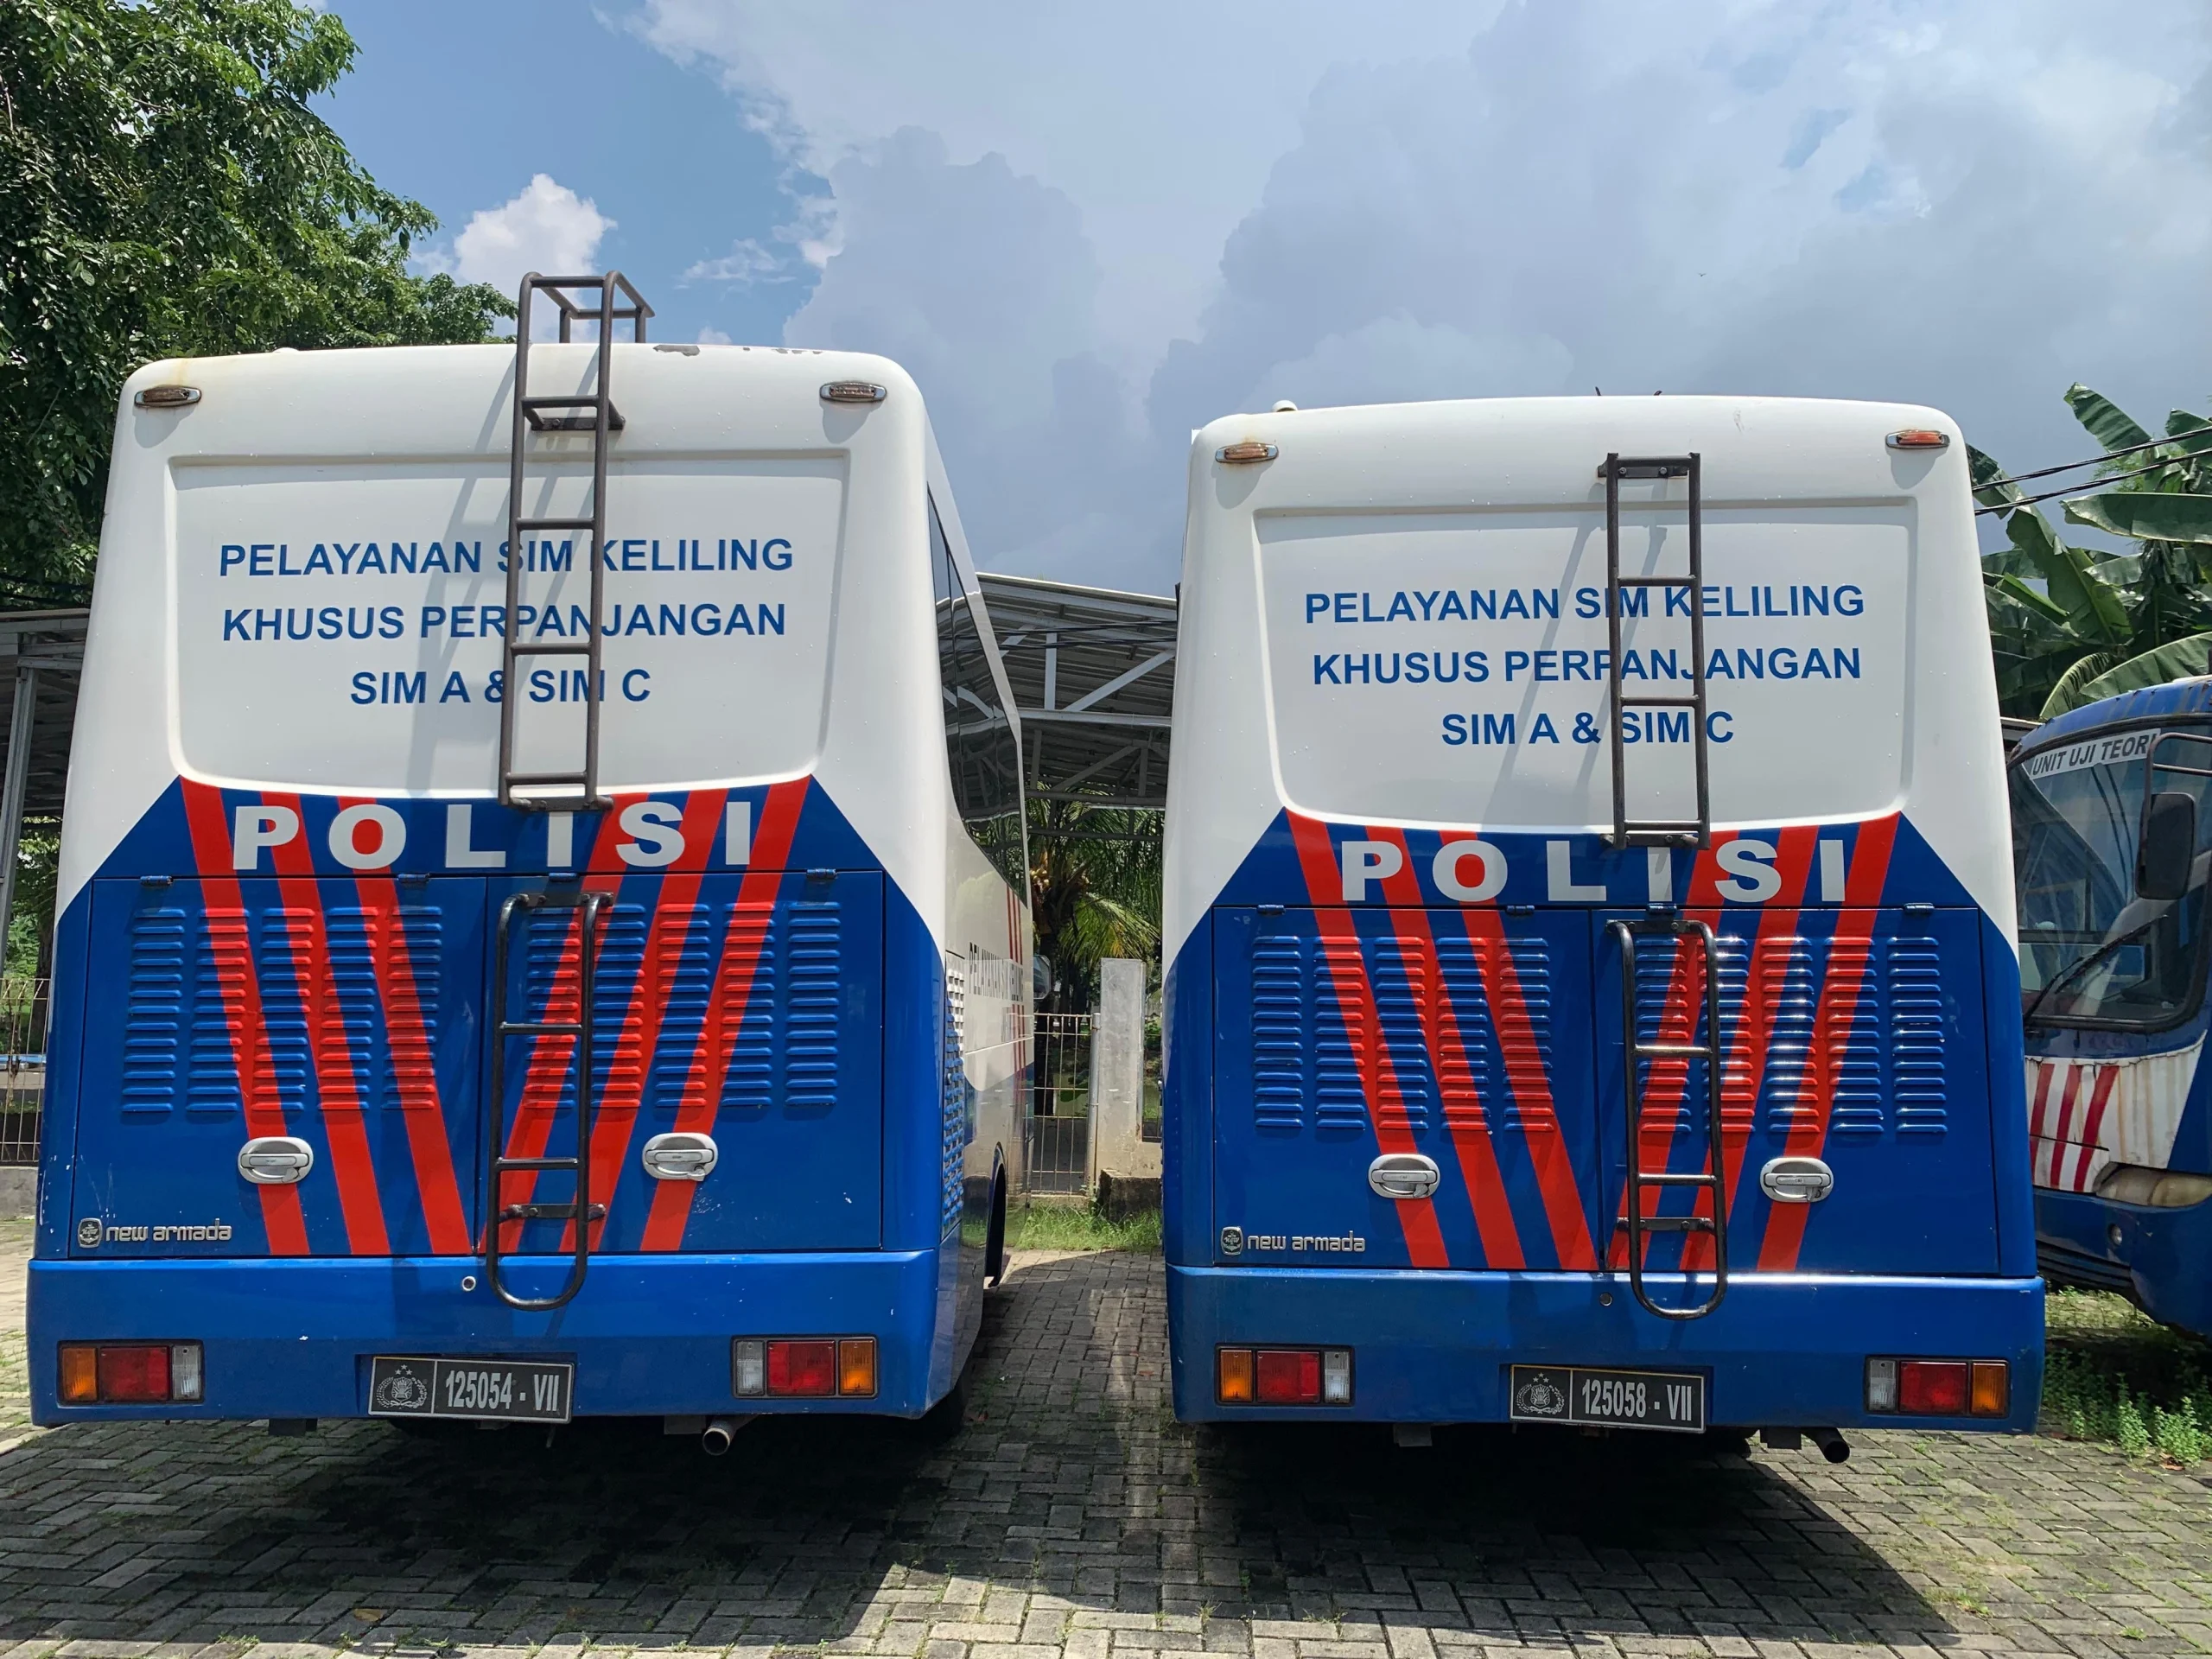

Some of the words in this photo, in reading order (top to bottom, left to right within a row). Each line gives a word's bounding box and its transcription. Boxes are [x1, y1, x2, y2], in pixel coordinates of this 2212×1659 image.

[219, 541, 481, 576] PELAYANAN
[498, 540, 572, 573] SIM
[590, 538, 792, 571] KELILING
[223, 606, 405, 641] KHUSUS
[421, 603, 785, 639] PERPANJANGAN
[1306, 588, 1560, 623] PELAYANAN
[1665, 585, 1864, 617] KELILING
[351, 671, 427, 704] SIM
[439, 671, 471, 703] A
[484, 670, 504, 702] &
[529, 669, 606, 702] SIM
[621, 669, 651, 702] C
[1313, 651, 1490, 684] KHUSUS
[1441, 713, 1516, 745] SIM
[1529, 713, 1560, 744] A
[1572, 712, 1601, 744] &
[1622, 711, 1690, 743] SIM
[1707, 711, 1733, 743] C
[2031, 752, 2067, 775] UNIT
[2069, 743, 2096, 766] UJI
[232, 800, 751, 871] POLISI
[1341, 839, 1846, 903] POLISI
[105, 1226, 148, 1242] new
[153, 1217, 232, 1242] armada
[1247, 1235, 1287, 1249] new
[1292, 1230, 1365, 1252] armada
[446, 1370, 512, 1409] 125054
[533, 1374, 559, 1411] VII
[1582, 1378, 1646, 1418] 125058
[1667, 1384, 1692, 1421] VII
